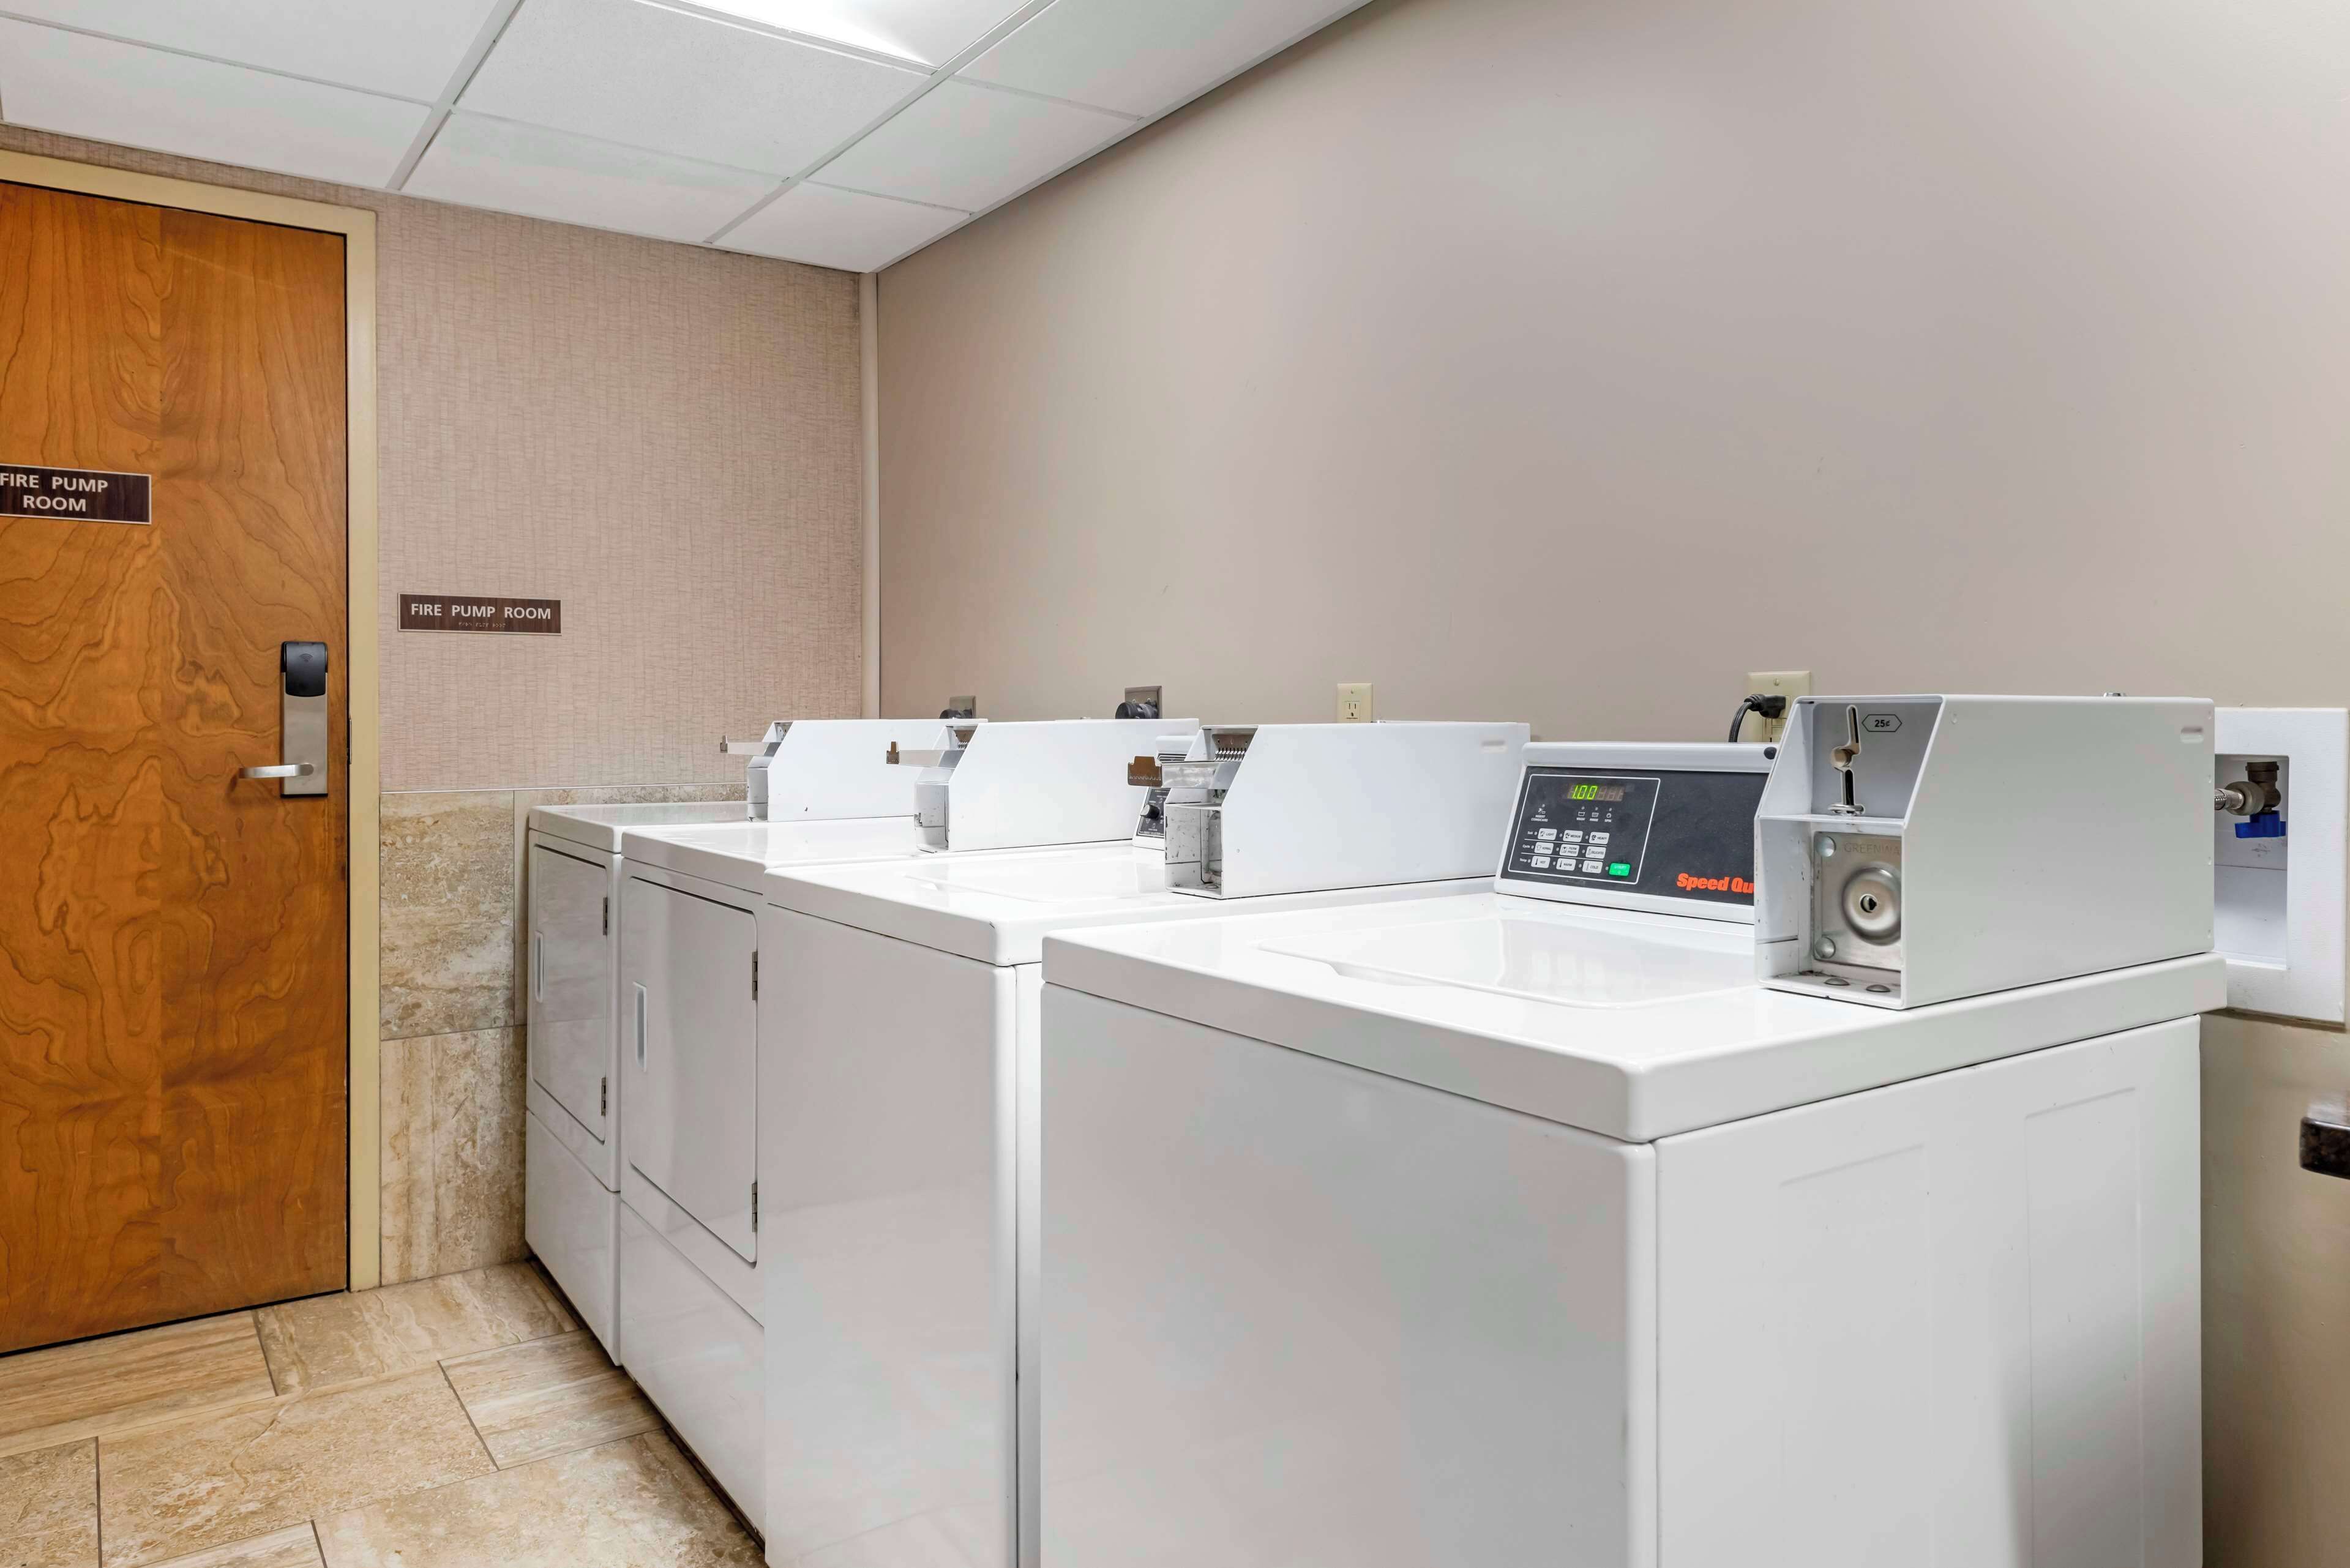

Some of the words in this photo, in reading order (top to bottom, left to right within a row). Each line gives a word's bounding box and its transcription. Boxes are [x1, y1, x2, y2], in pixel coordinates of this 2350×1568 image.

[0, 473, 39, 488] FIRE
[52, 476, 108, 493] PUMP
[23, 495, 87, 512] ROOM
[411, 603, 442, 616] FIRE
[452, 605, 496, 618] PUMP
[504, 607, 551, 620] ROOM
[1844, 843, 1901, 856] GREENWA
[1677, 872, 1730, 891] Speed
[1731, 877, 1754, 894] Qu
